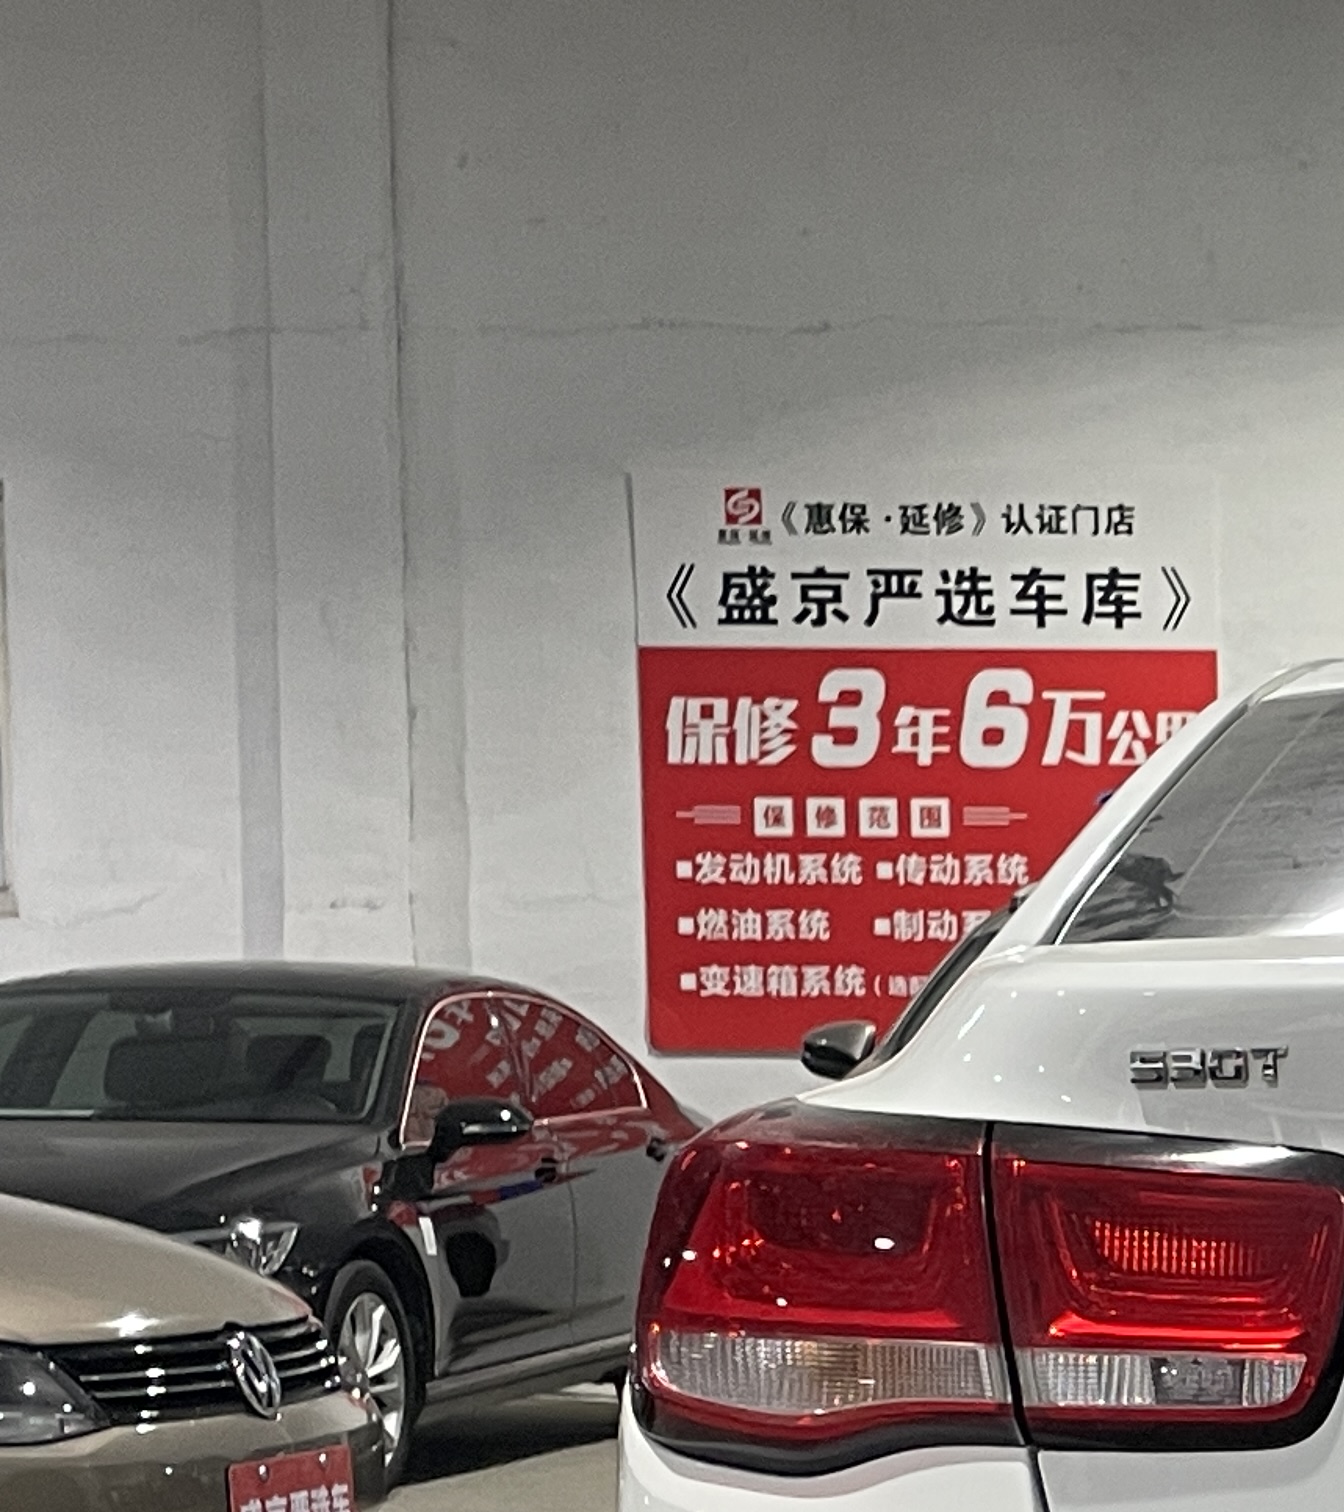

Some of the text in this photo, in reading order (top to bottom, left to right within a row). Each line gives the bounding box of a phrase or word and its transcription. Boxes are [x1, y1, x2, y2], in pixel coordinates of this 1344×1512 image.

[666, 563, 1192, 631] 《盛京严选车库》
[694, 851, 864, 887] 发动机系统
[895, 852, 1030, 887] 传动系统
[695, 907, 831, 942] 燃油系统
[698, 964, 867, 999] 变速箱系统
